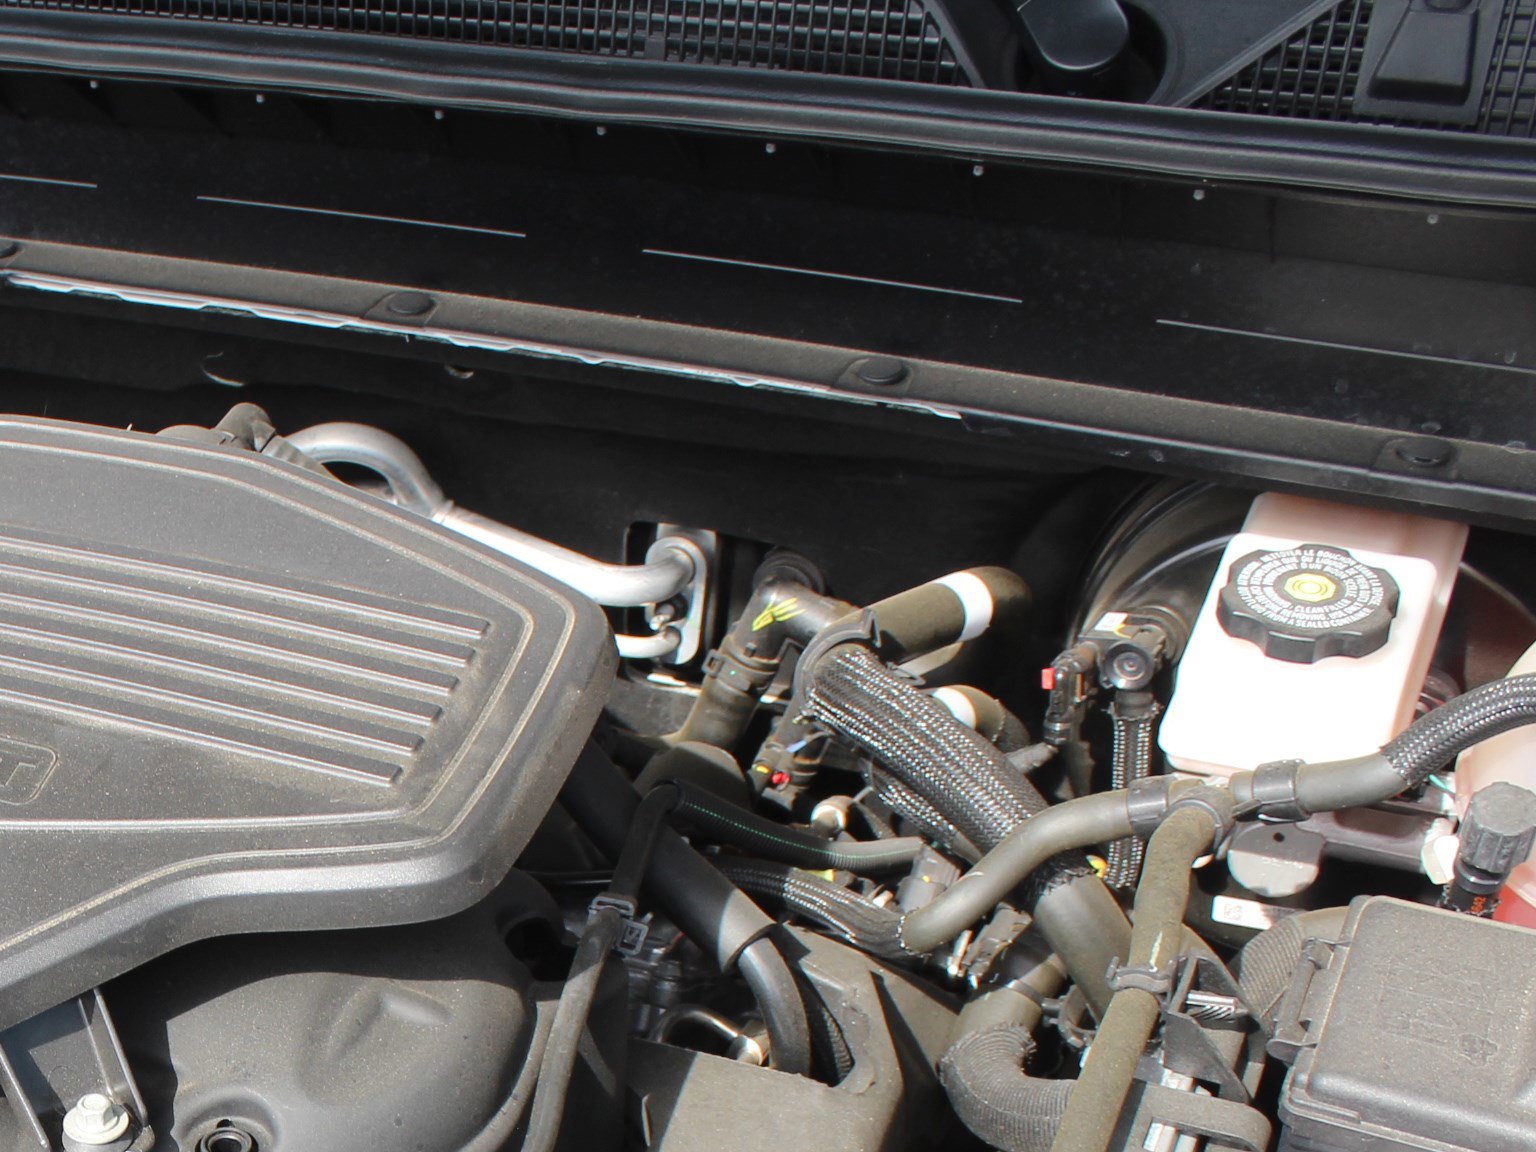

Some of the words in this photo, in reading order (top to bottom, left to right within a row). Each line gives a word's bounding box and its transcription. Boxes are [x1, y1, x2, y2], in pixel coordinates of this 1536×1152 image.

[1317, 550, 1357, 566] BOUCHON
[1294, 605, 1324, 613] CLEAN
[1295, 619, 1330, 628] SEALED
